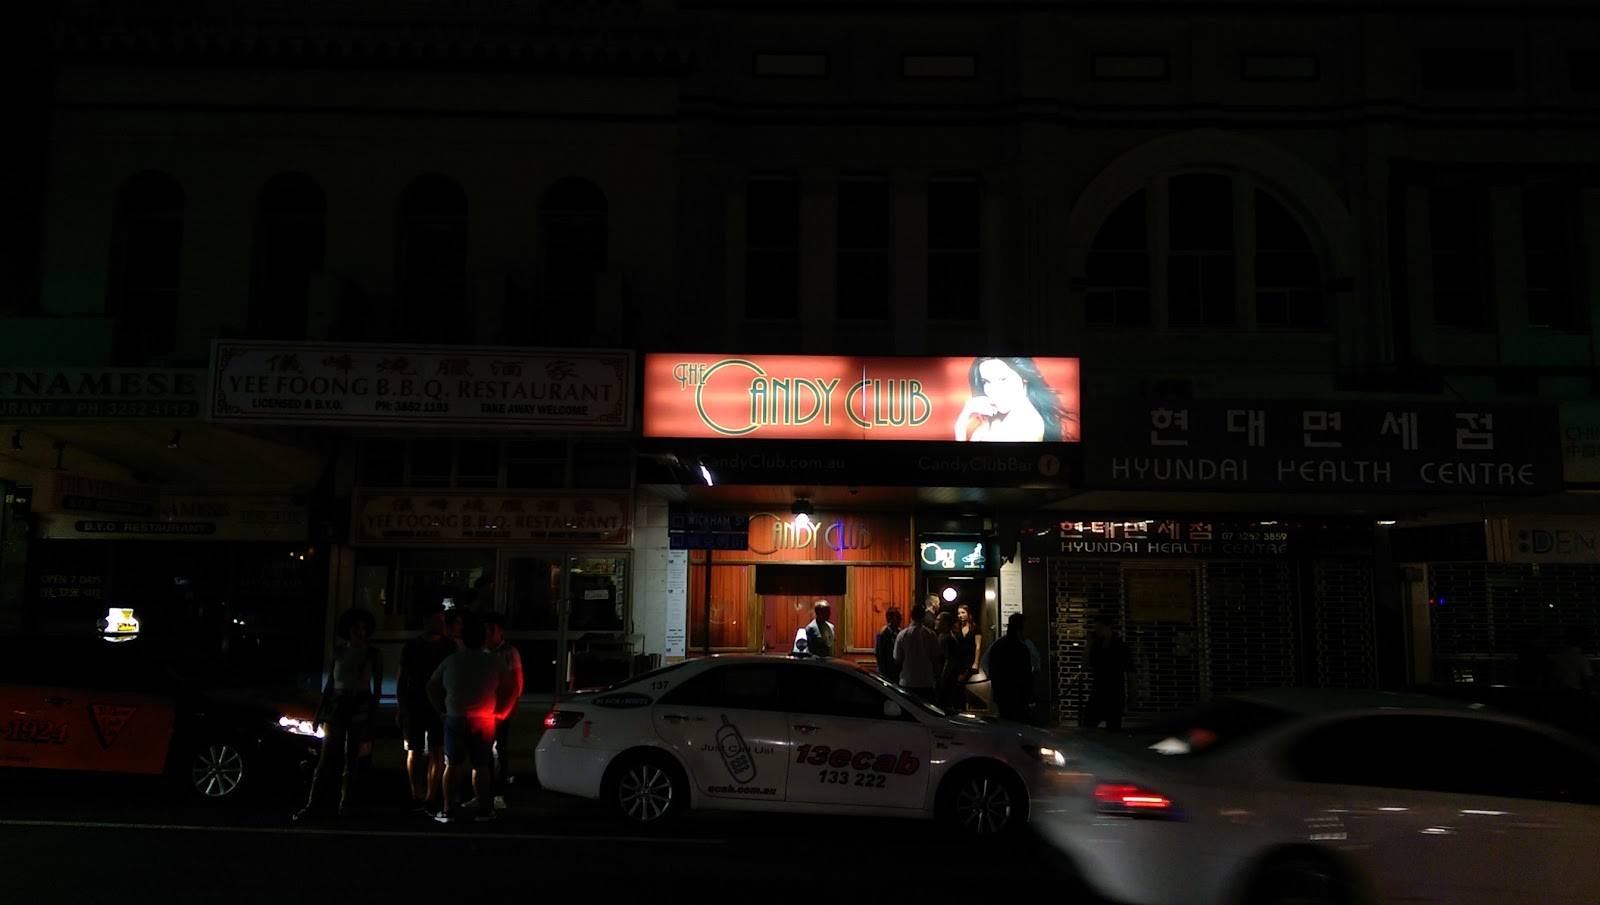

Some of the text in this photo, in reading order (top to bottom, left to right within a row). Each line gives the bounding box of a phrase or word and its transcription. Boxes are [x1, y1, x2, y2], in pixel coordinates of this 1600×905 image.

[230, 376, 611, 401] YEE FOONG B.B.Q. RESTAURANT
[672, 358, 933, 435] THE CANDY CLUB
[252, 398, 301, 409] LICENSED
[480, 403, 589, 416] TAKE AWAY WELCOME
[1111, 457, 1536, 487] HYUNDAI HEALTH CENTRE
[367, 514, 392, 529] YEE
[1061, 541, 1288, 555] HYUNDAI HEALTH CENTRE
[651, 680, 669, 690] 137
[796, 744, 920, 775] 13ecab
[818, 769, 887, 788] 133 222
